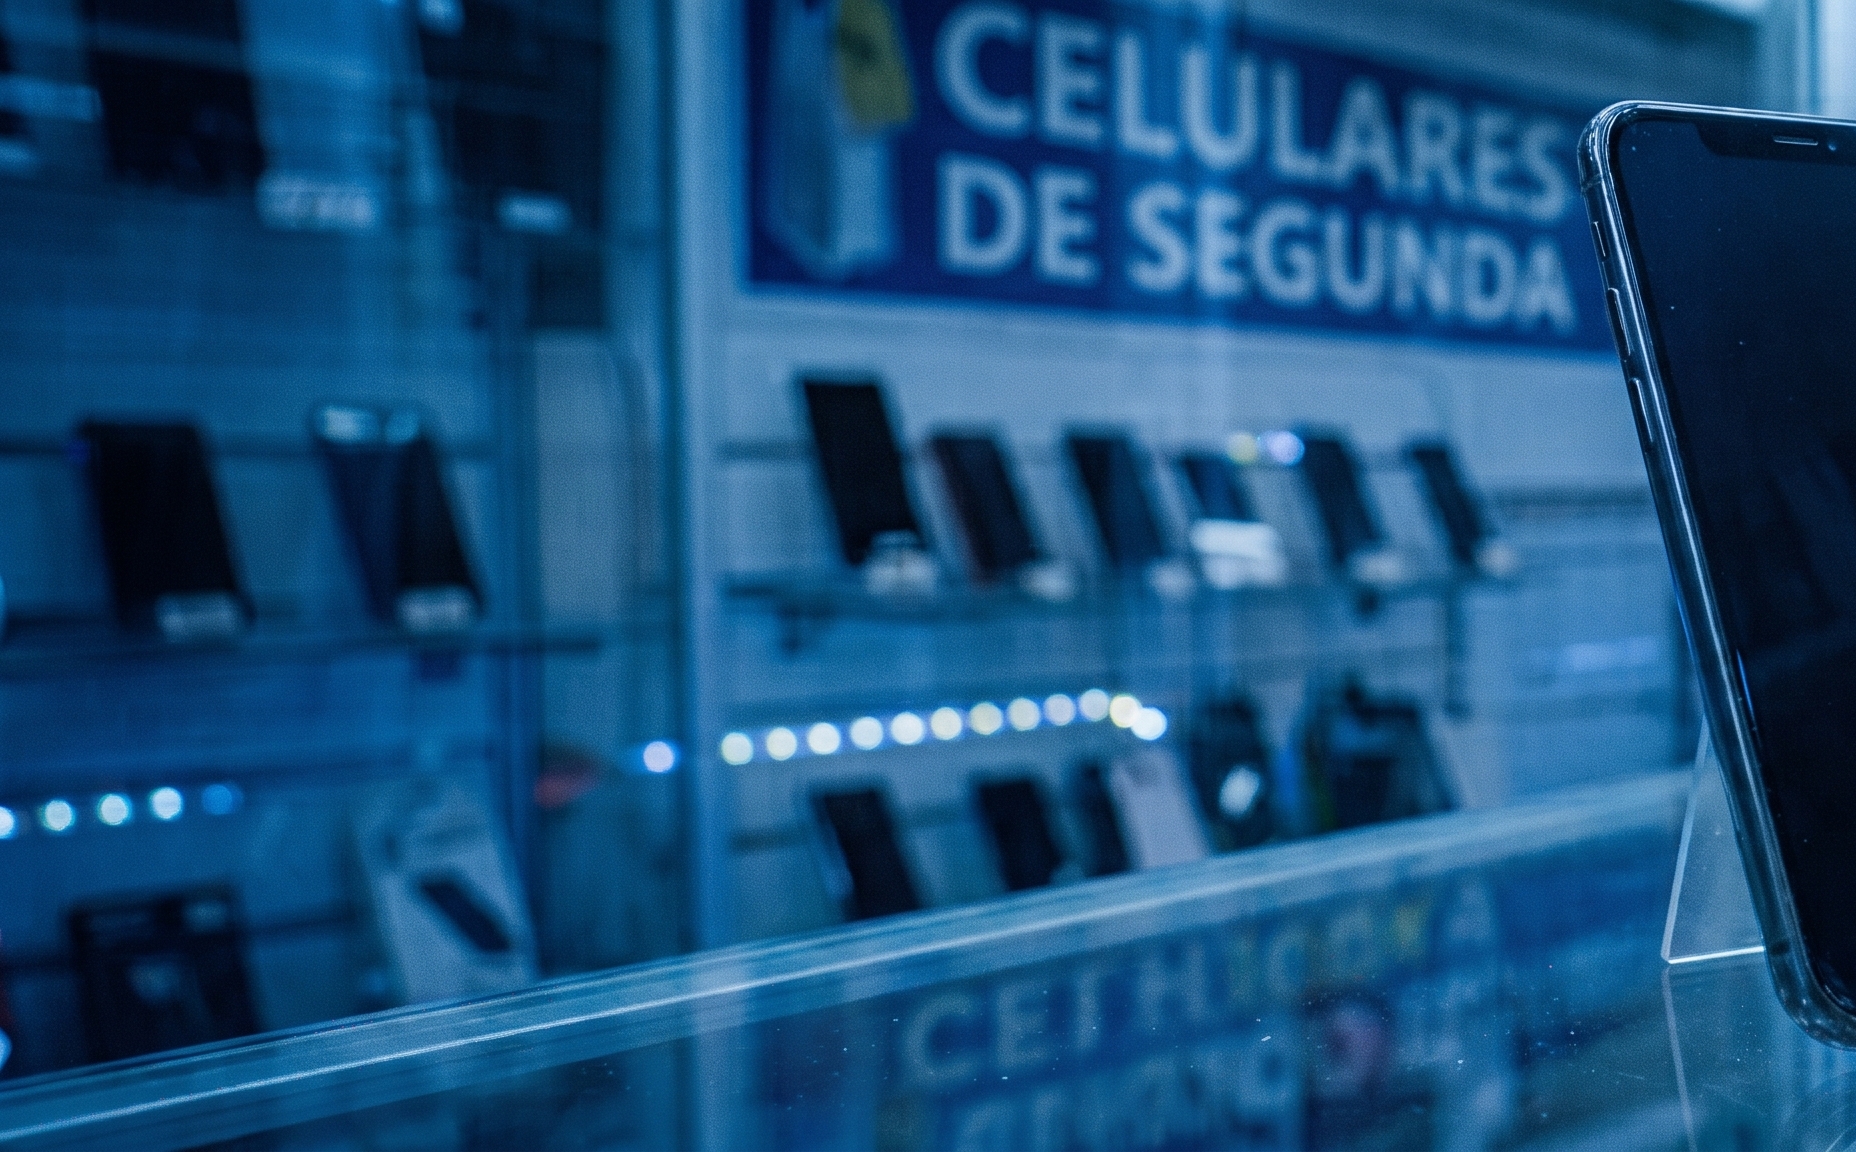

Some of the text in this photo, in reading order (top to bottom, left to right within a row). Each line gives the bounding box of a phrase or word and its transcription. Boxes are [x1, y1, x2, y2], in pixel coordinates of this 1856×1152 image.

[932, 5, 1574, 222] CELULARES
[936, 155, 1577, 334] DE SEGUNDA
